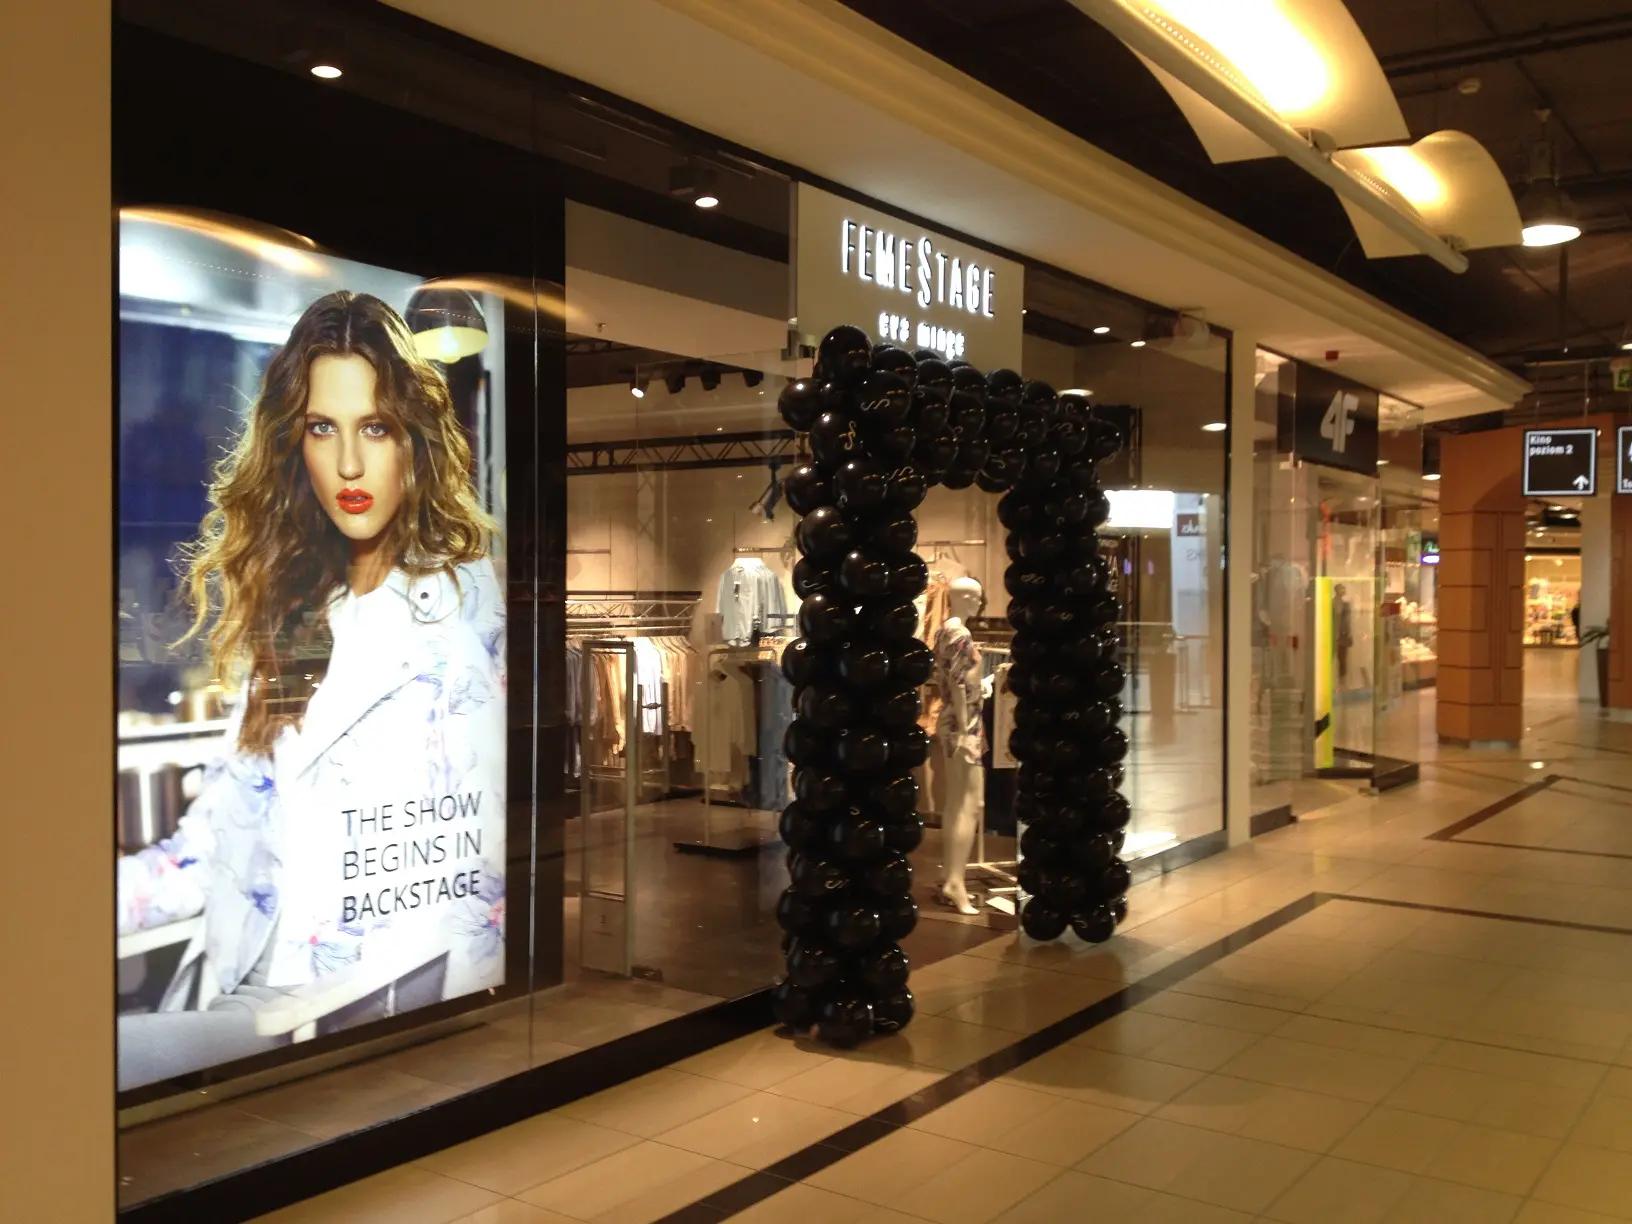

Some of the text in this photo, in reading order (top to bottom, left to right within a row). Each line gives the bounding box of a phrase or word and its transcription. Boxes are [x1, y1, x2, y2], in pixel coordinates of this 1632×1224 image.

[842, 218, 996, 318] FEMESTAGE
[1320, 389, 1360, 453] 4F
[1565, 444, 1574, 455] 2
[341, 790, 483, 837] THE SHOW
[343, 828, 482, 881] BEGINS IN
[341, 869, 481, 924] BACKSTAGE
